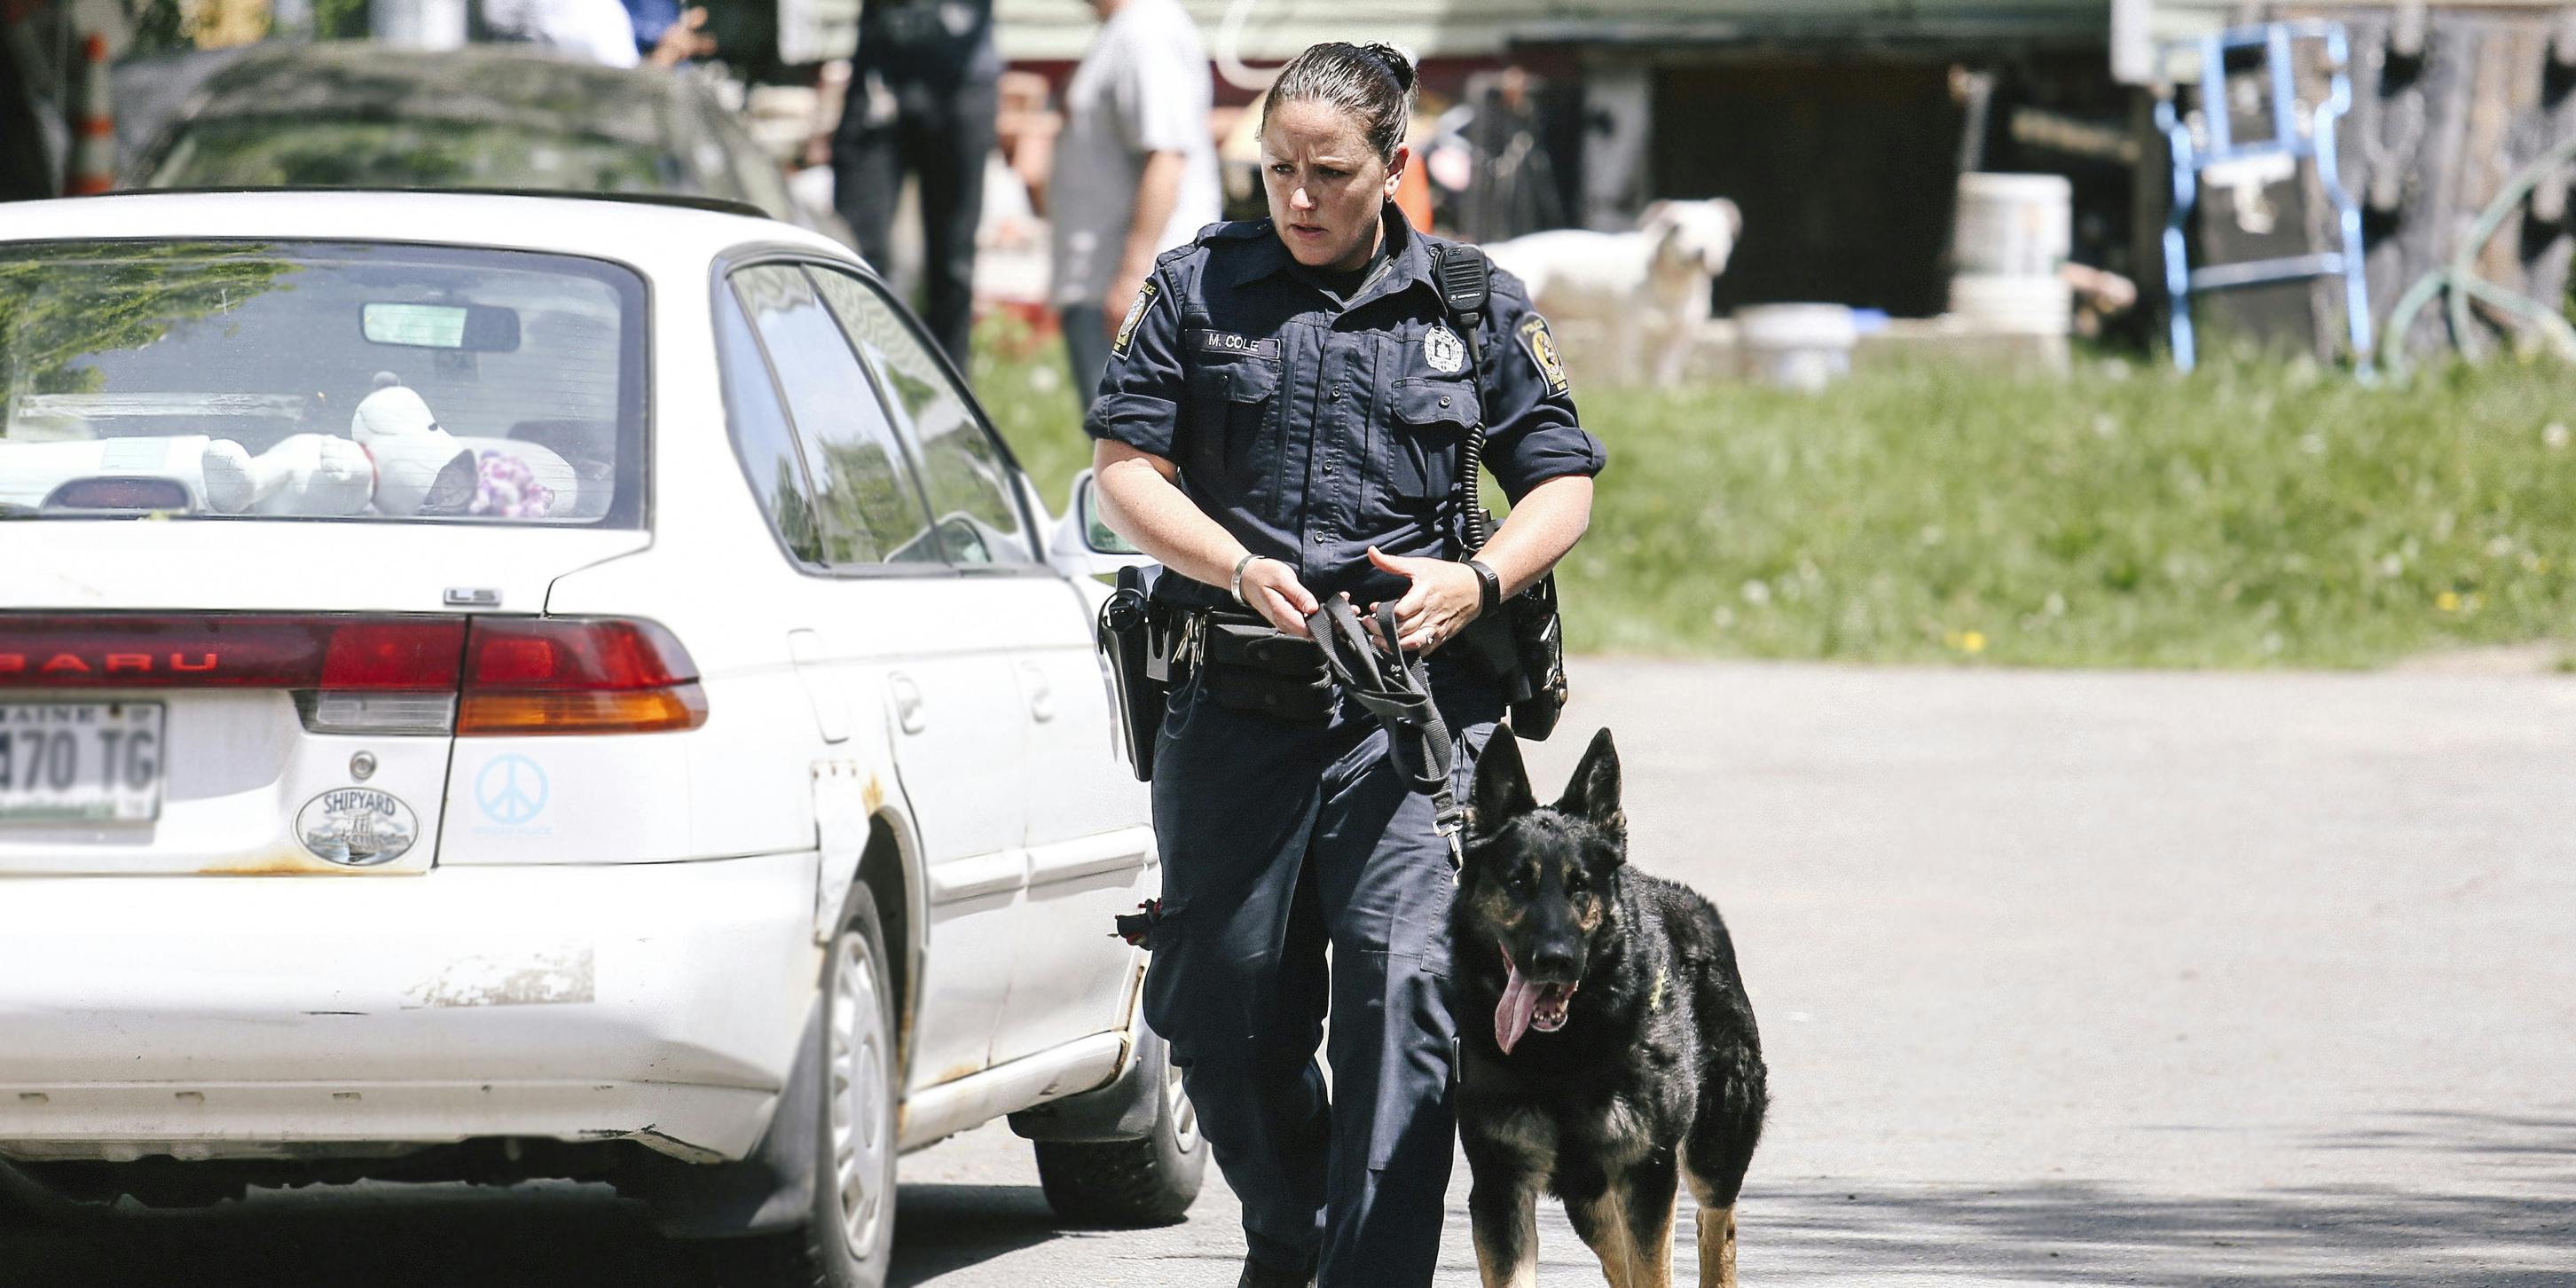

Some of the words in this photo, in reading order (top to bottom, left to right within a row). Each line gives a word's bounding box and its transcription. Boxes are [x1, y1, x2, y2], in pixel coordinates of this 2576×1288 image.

[1208, 334, 1221, 347] M.
[1226, 335, 1260, 352] COLE
[450, 589, 496, 601] LS
[98, 728, 155, 792] TG
[324, 791, 396, 816] SHIPYARD
